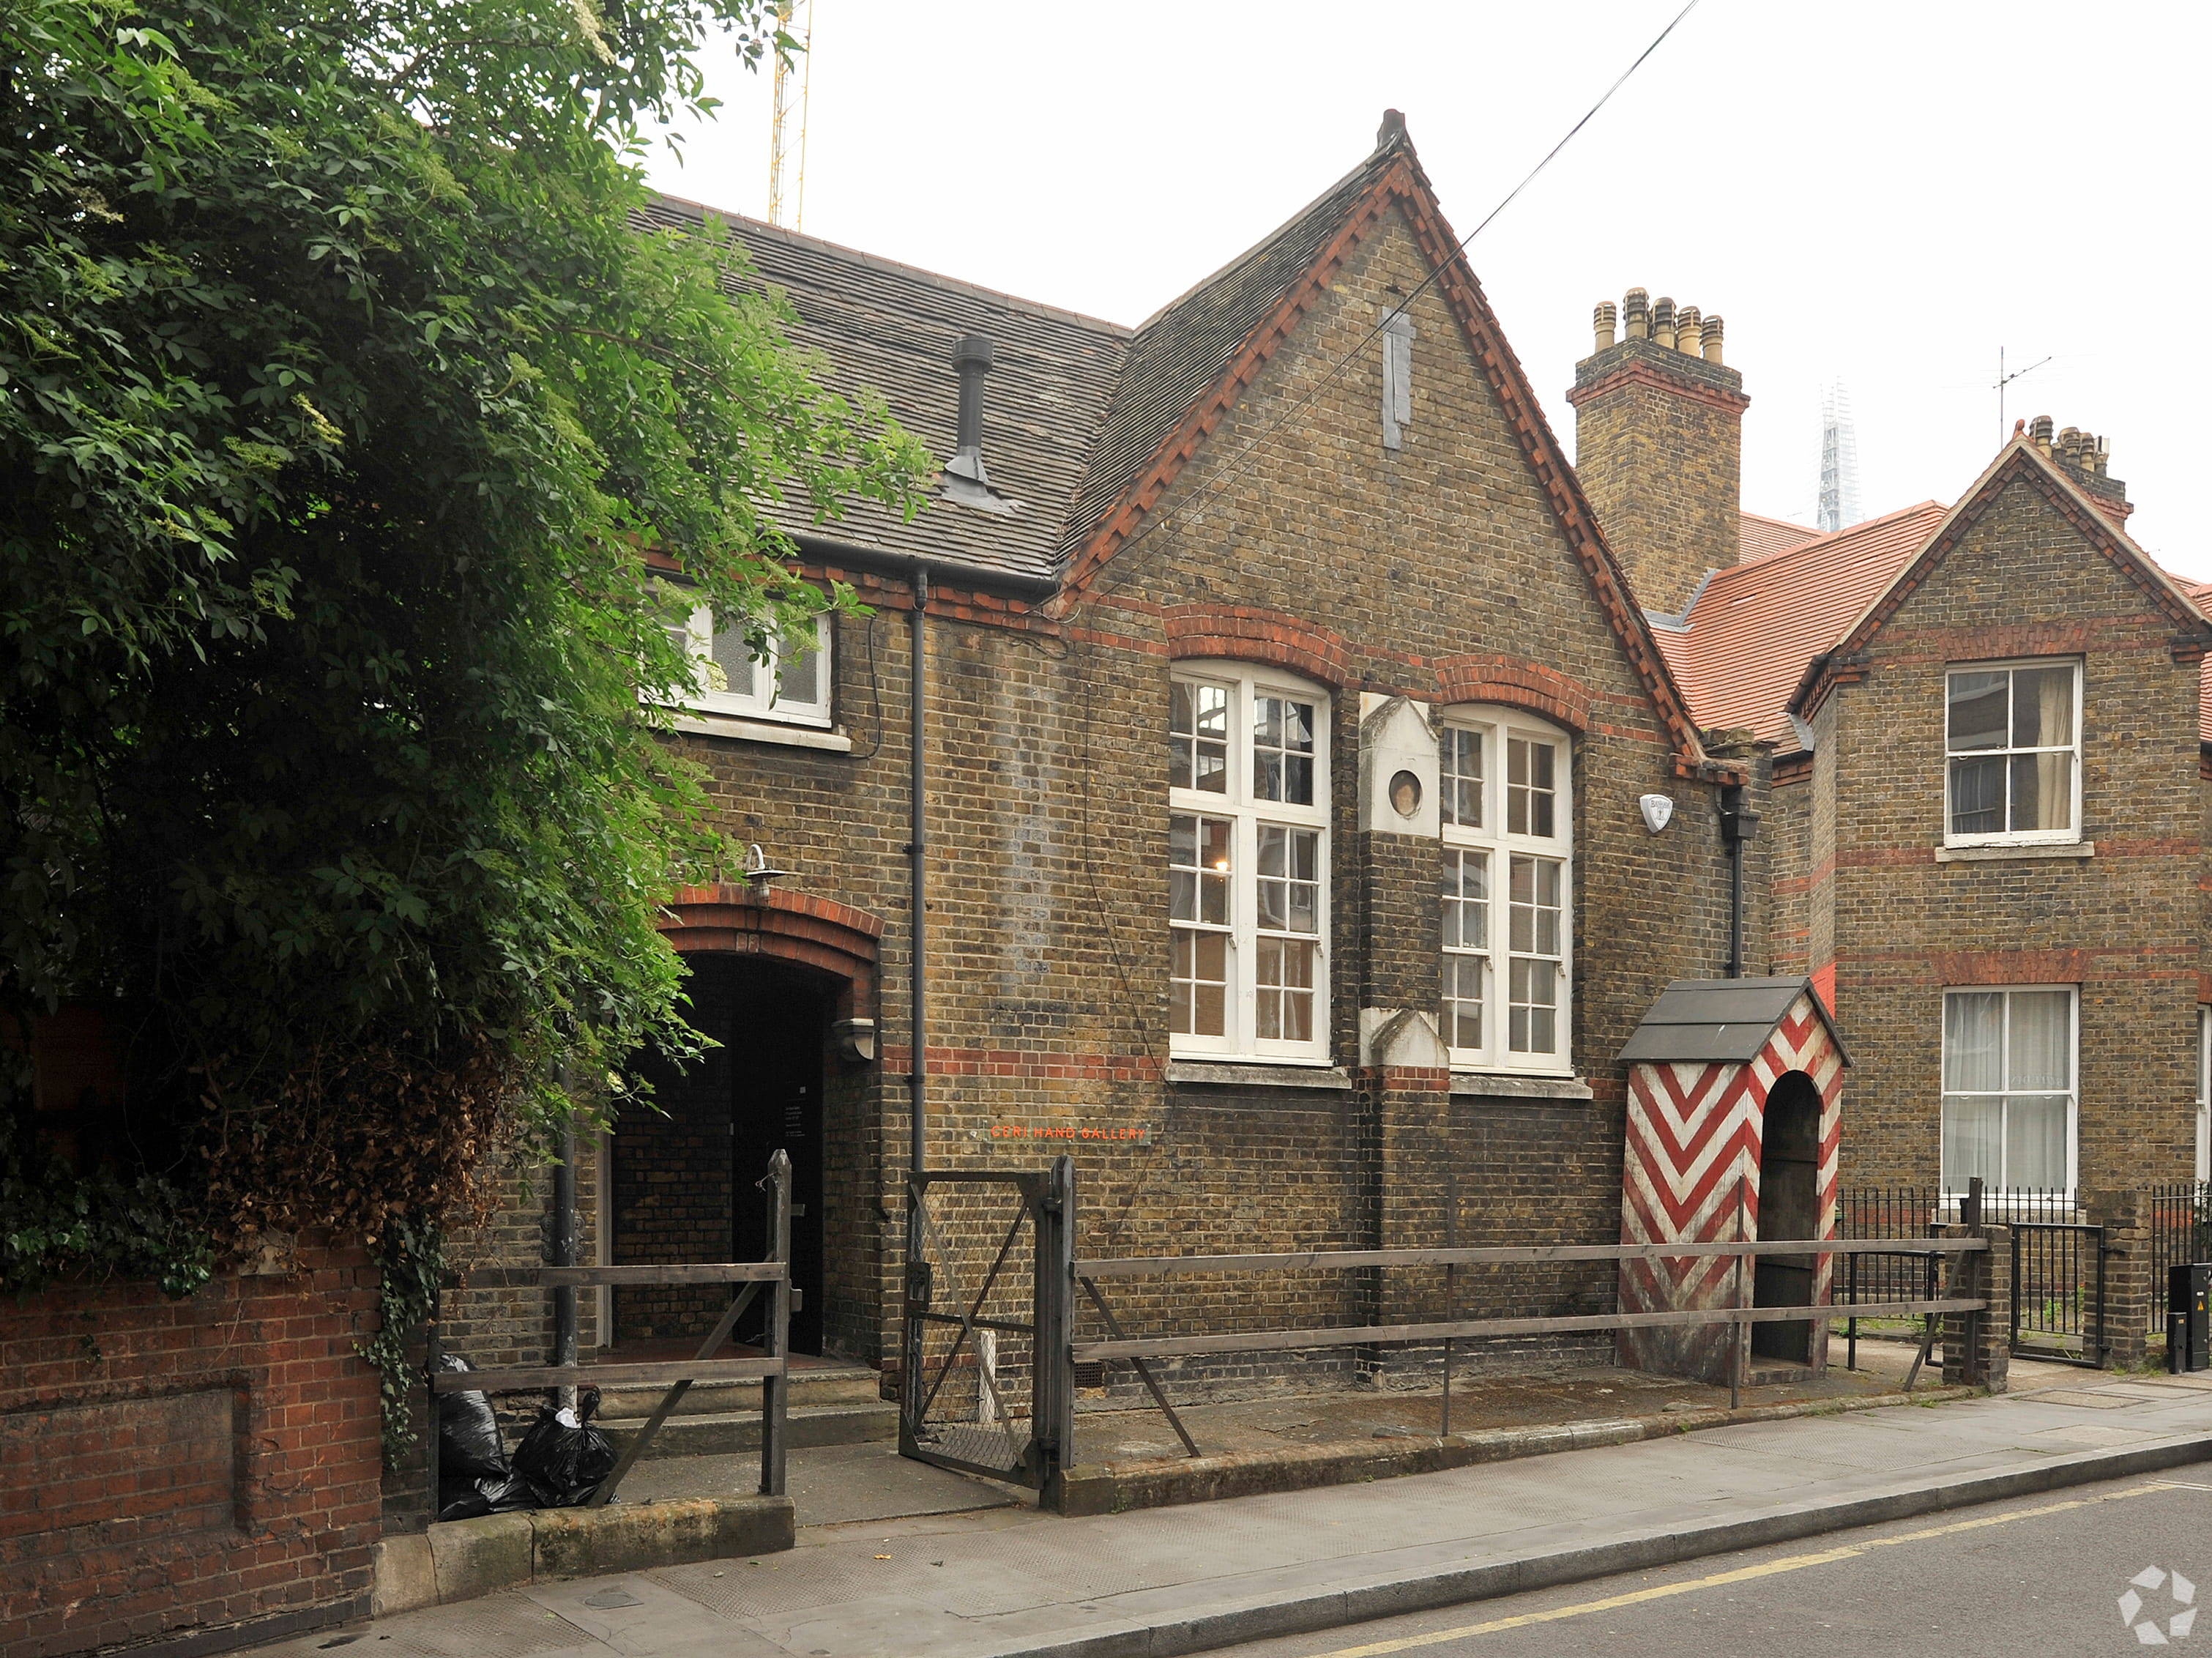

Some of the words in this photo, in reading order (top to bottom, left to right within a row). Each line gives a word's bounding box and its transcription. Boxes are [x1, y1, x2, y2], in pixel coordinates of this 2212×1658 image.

[990, 1125, 1027, 1137] CERI
[1033, 1126, 1075, 1139] HAND
[1081, 1127, 1146, 1140] GALLERY
